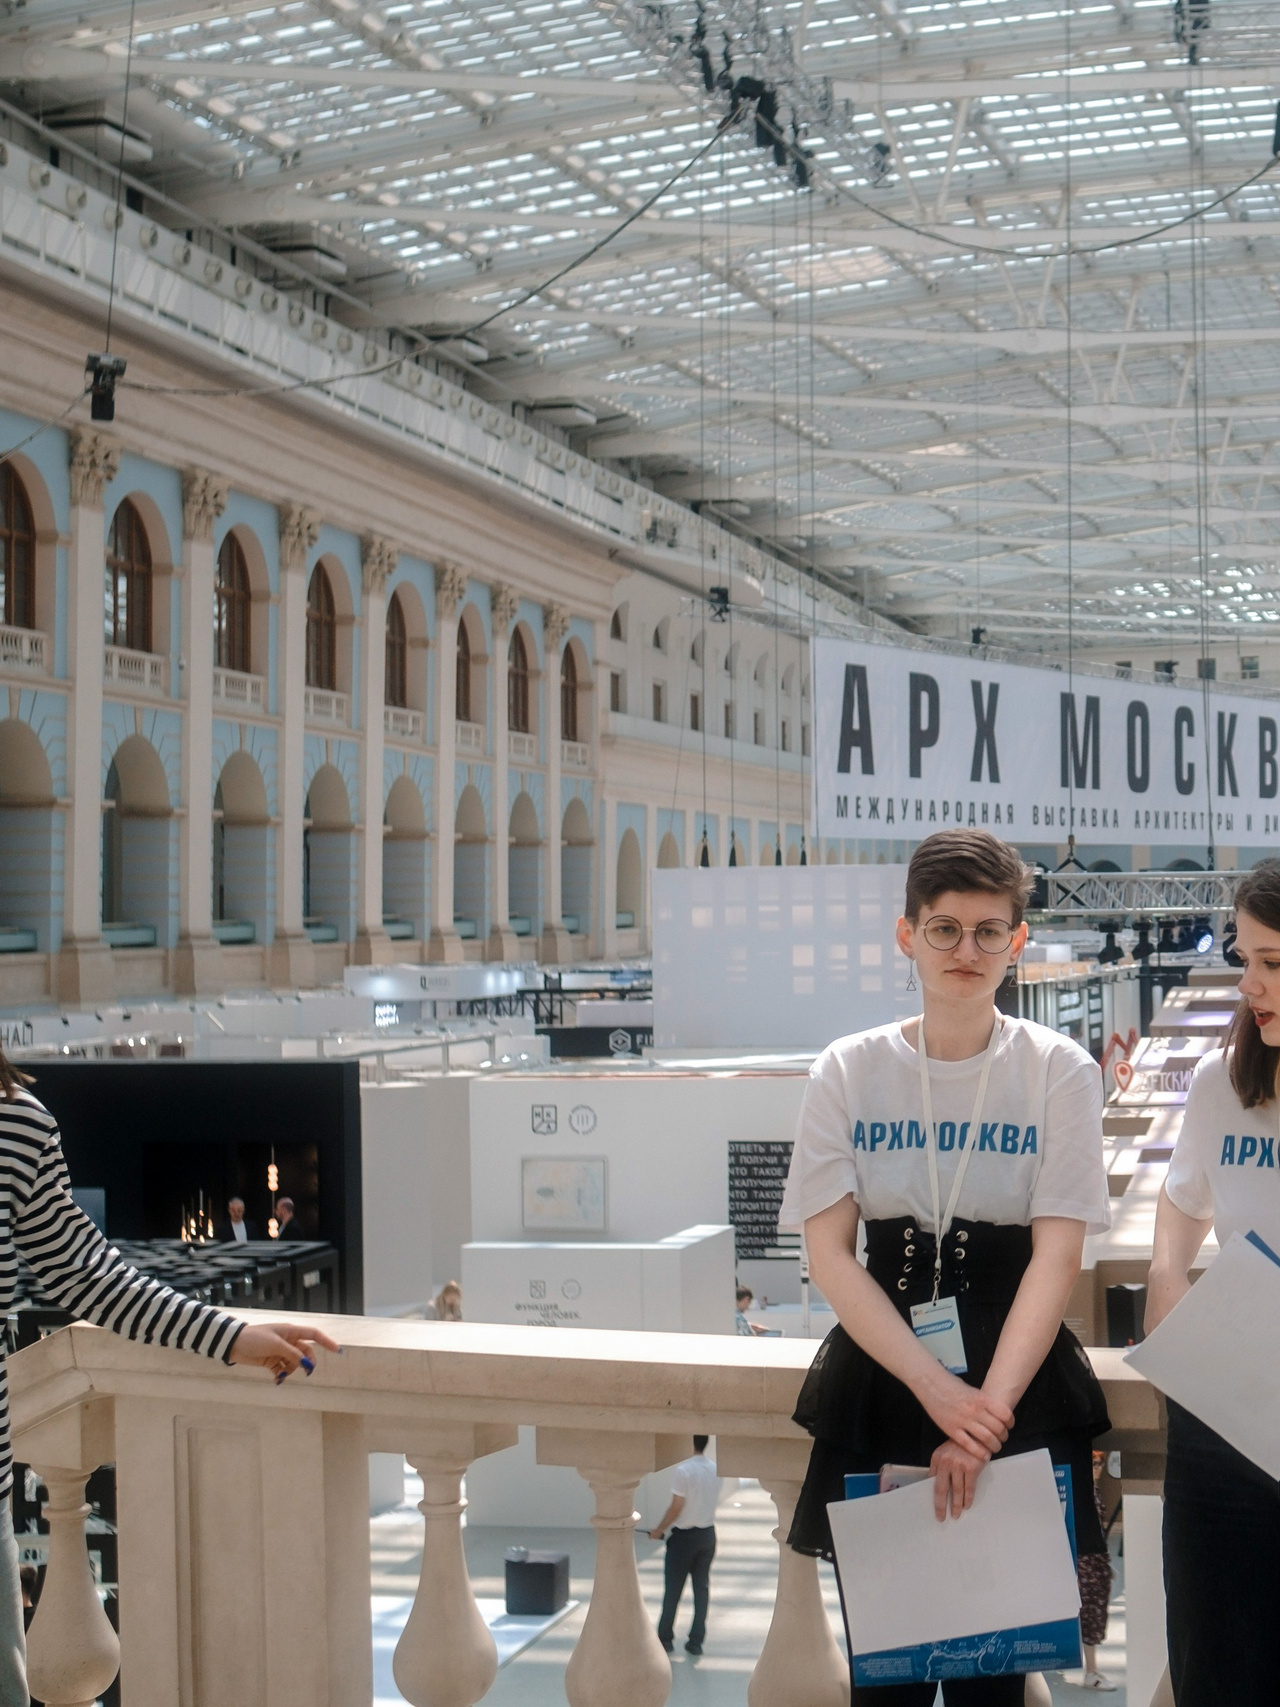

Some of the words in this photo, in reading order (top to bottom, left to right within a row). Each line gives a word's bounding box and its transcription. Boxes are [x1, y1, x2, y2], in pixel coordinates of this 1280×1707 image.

[837, 662, 1000, 784] АРХ
[836, 795, 1014, 826] МЕЖДУНАРОДНАЯ
[1033, 805, 1119, 828] ВЫСТАВКА
[1134, 809, 1234, 832] АРХИТЕКТУРЫ
[1247, 813, 1252, 832] И
[729, 1144, 765, 1153] ОТВЕТЬ
[770, 1144, 784, 1153] НА
[739, 1155, 778, 1165] ПОЛУЧИ
[753, 1167, 784, 1177] ТАКОЕ
